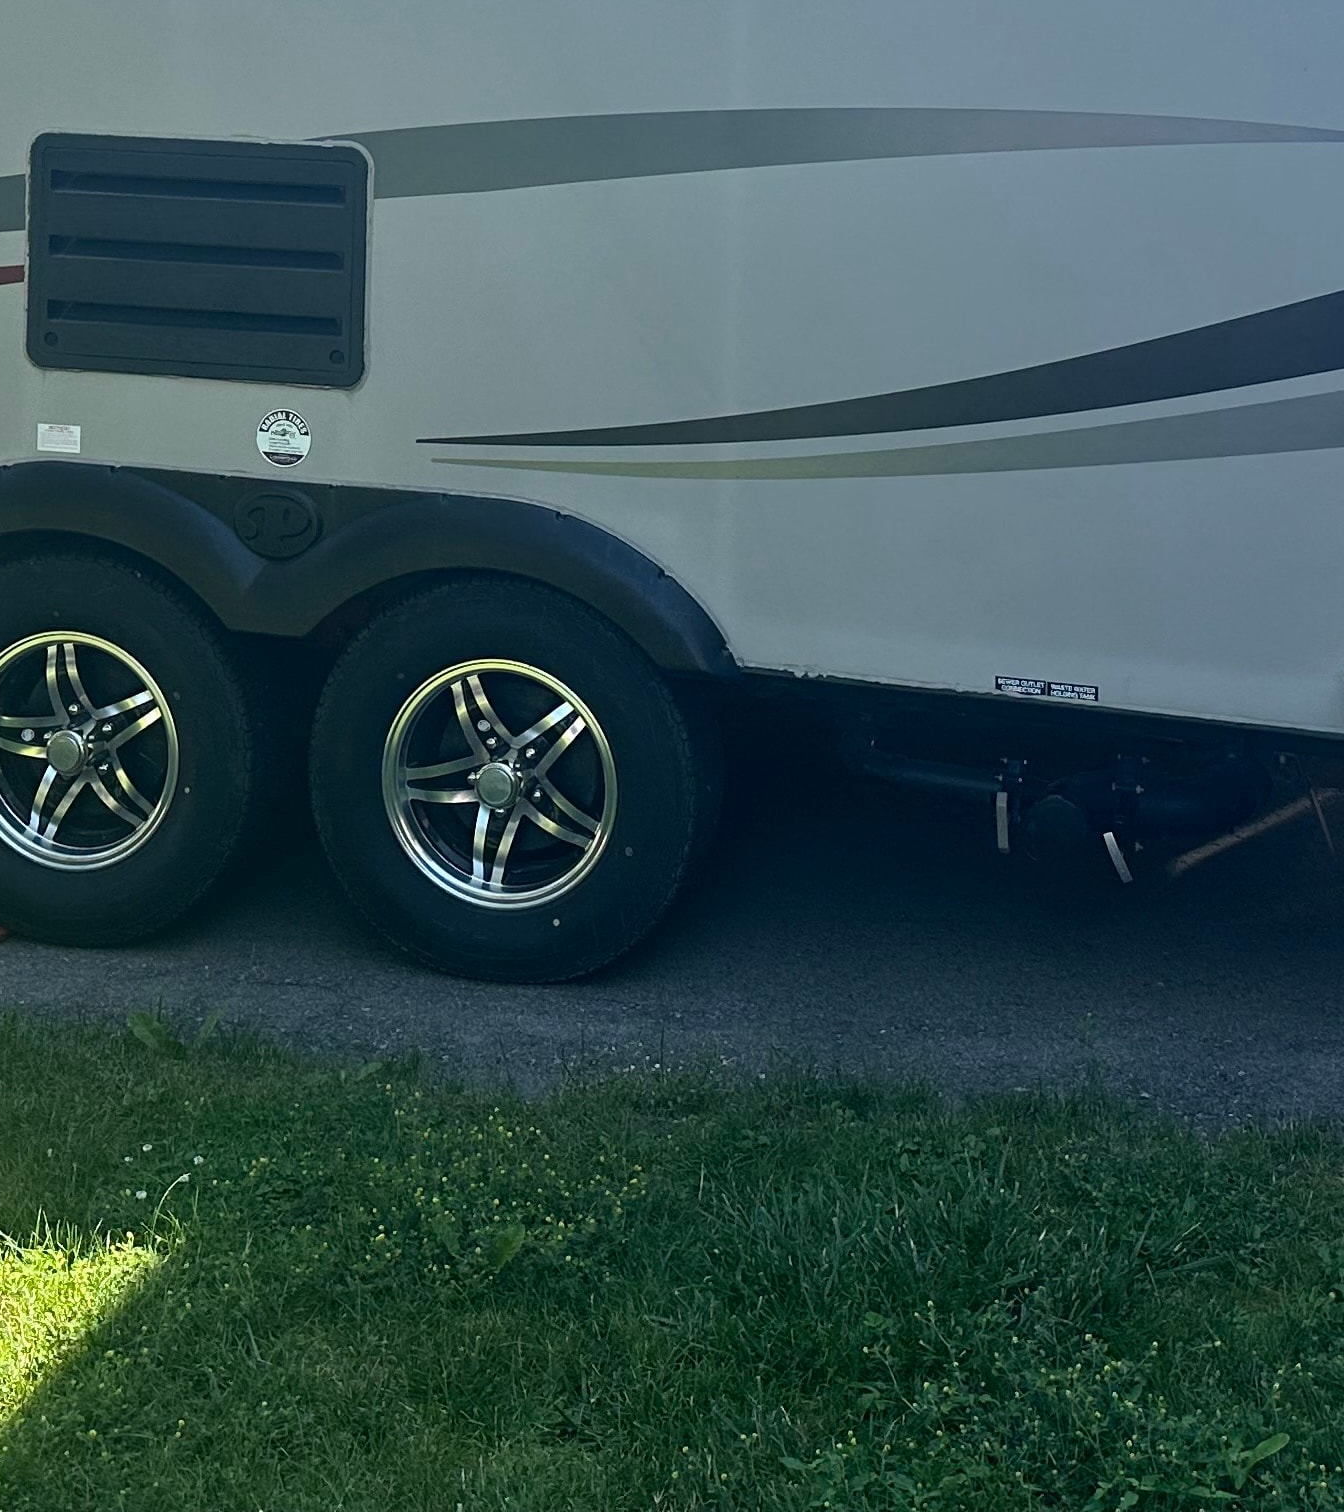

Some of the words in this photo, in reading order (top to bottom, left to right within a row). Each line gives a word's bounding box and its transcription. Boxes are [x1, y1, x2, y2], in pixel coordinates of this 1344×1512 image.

[260, 411, 287, 431] RADIAL
[288, 413, 308, 435] TIRES
[1020, 679, 1046, 688] OUTLET
